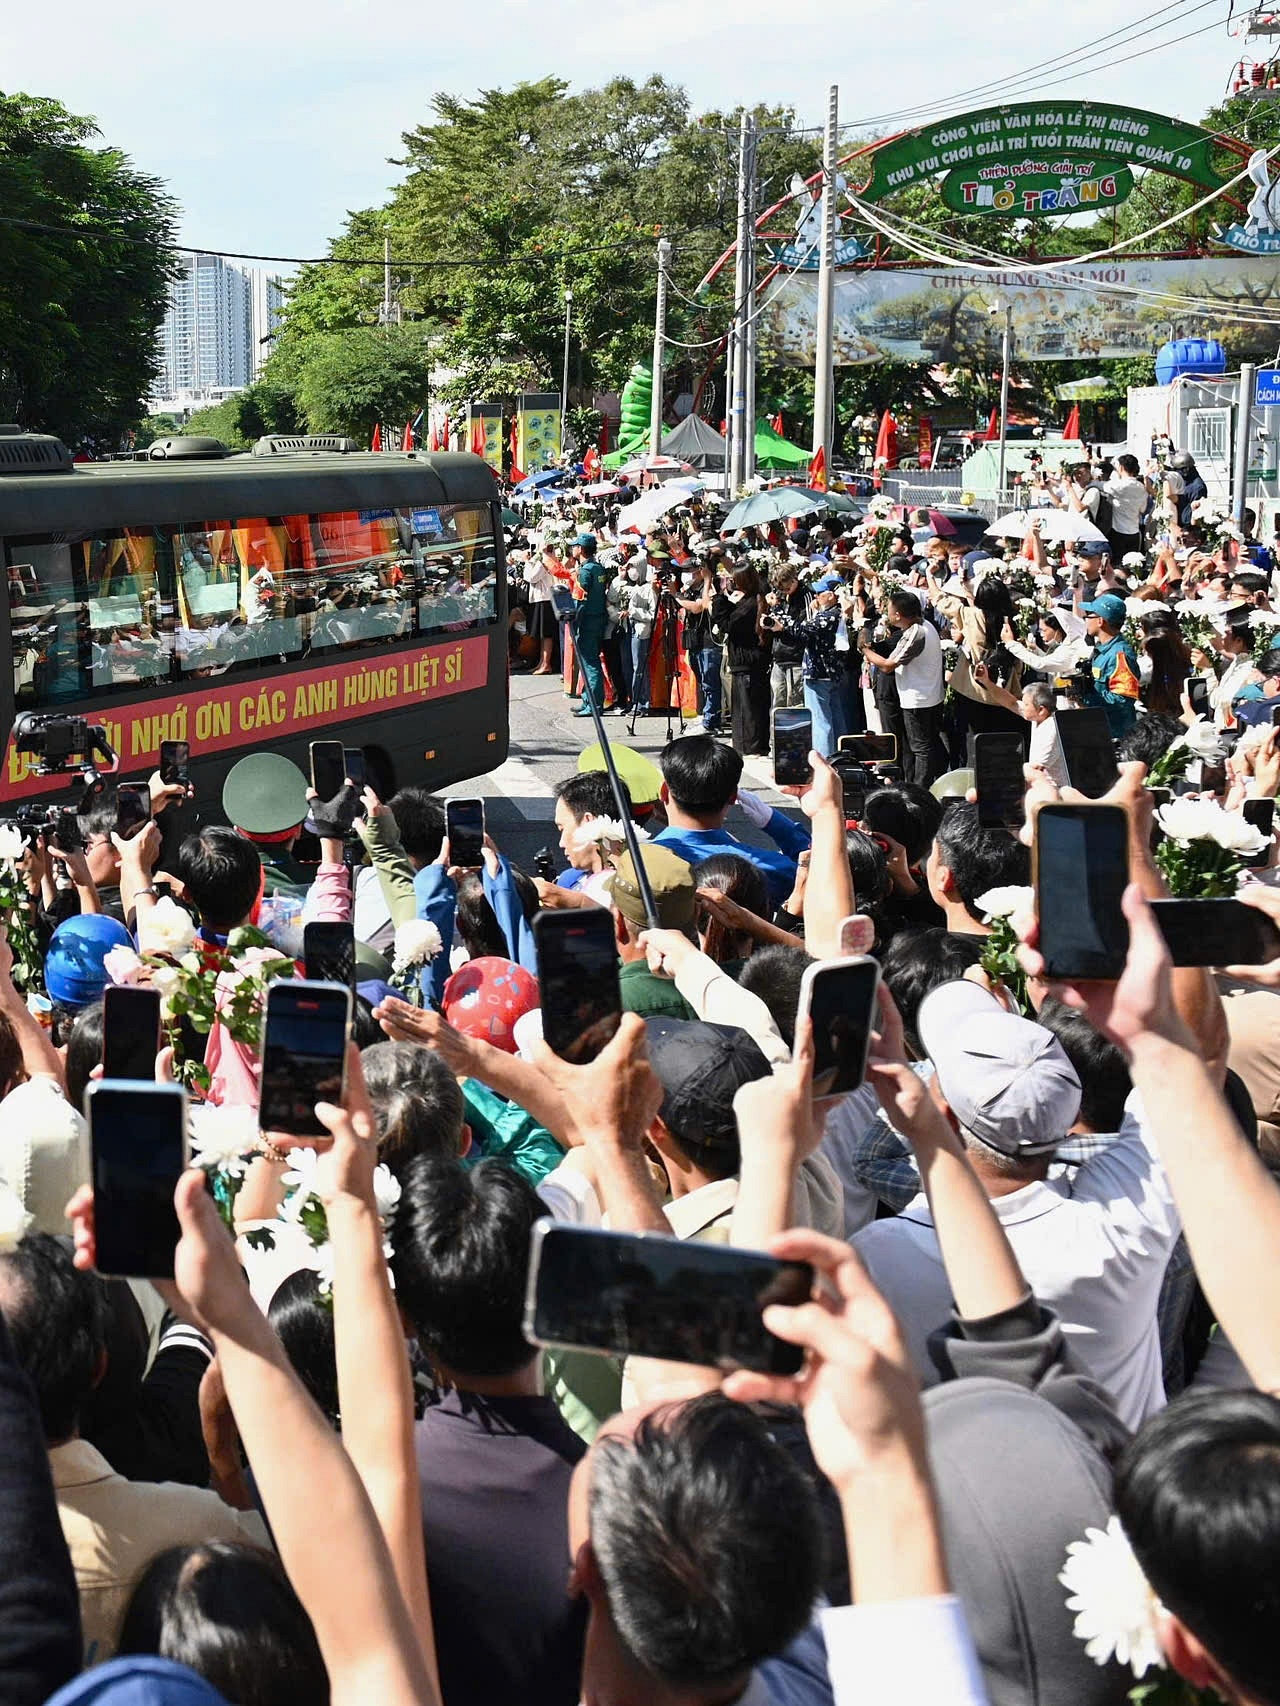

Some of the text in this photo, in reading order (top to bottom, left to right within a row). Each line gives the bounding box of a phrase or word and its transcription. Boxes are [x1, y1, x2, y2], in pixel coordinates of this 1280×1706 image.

[931, 110, 1149, 147] CÔNG VIÊN VĂN HÓA LÊ THỊ RIÊNG
[886, 128, 1192, 186] KHU VUI CHƠI GIẢI TRÍ TUỔI THẦN TIÊN QUẬN 10
[978, 162, 1009, 180] THIÊN
[1051, 158, 1073, 174] GIẢI
[1075, 161, 1096, 176] TRÍ
[960, 176, 1117, 211] THỎ TRẮNG
[1089, 266, 1126, 283] MỚI
[1258, 387, 1275, 401] CÁCH
[131, 703, 187, 755] NHỚ
[195, 701, 231, 741] ƠN
[239, 686, 286, 731] CÁC
[293, 679, 337, 720] ANH
[343, 666, 398, 707] HÙNG
[403, 653, 440, 696] LIỆT
[444, 647, 464, 683] SĨ
